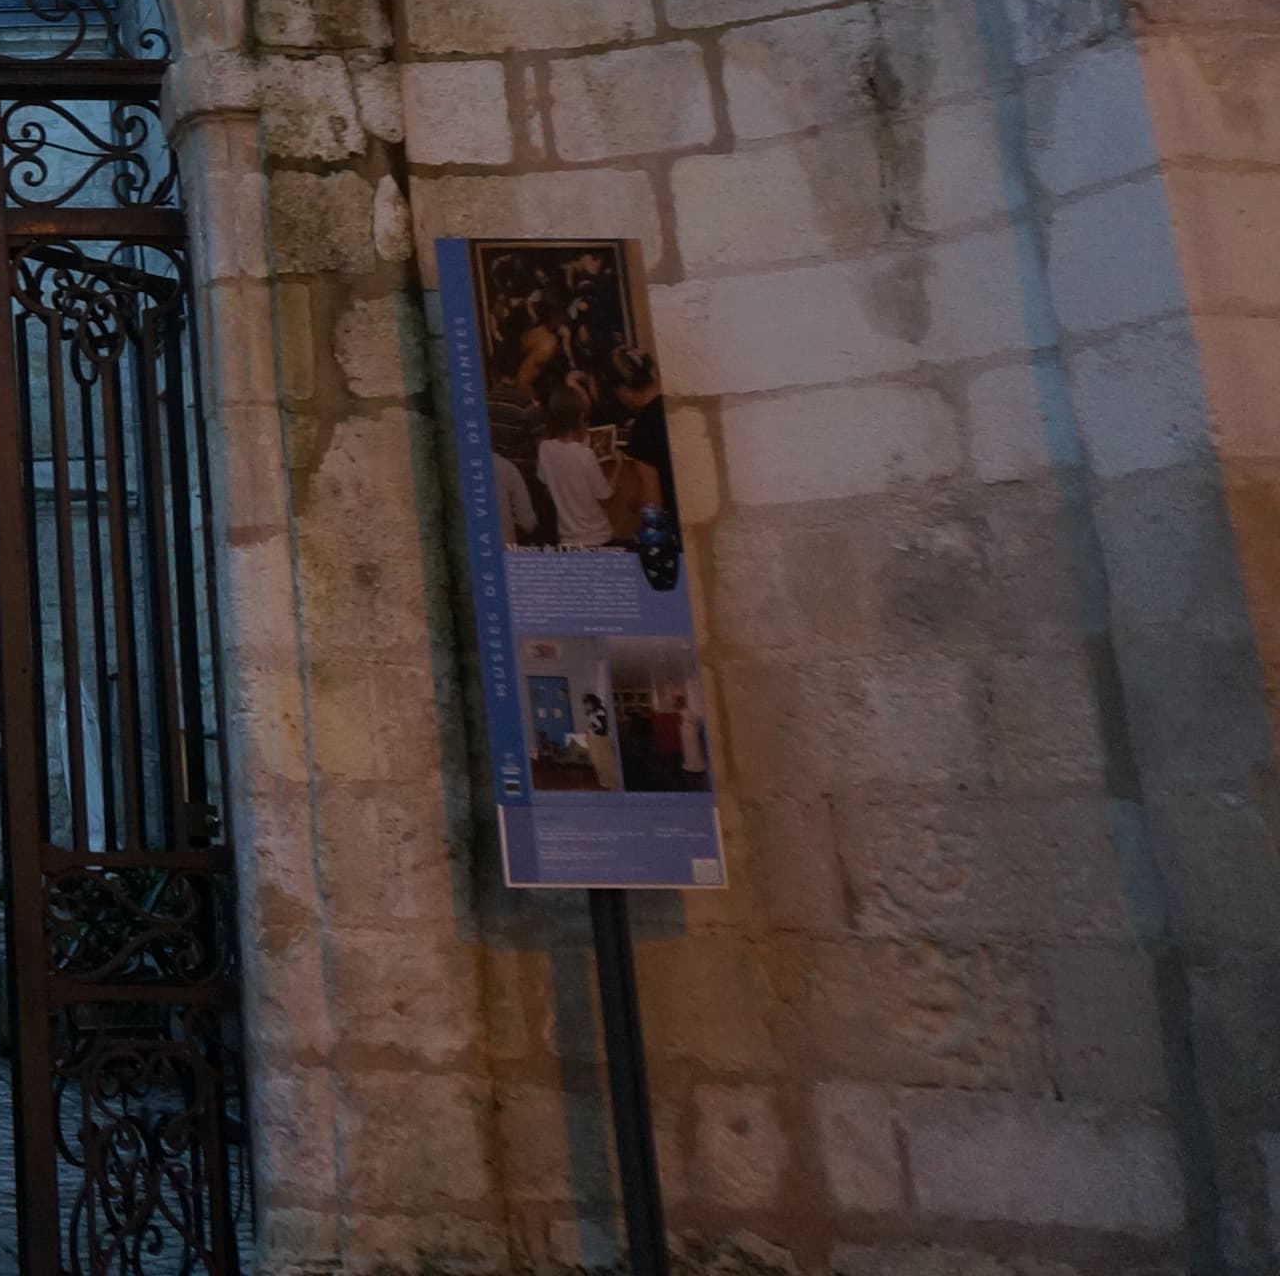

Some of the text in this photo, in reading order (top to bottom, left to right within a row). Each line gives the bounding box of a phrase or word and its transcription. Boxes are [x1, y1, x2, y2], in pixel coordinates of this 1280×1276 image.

[454, 315, 475, 405] SAINTES
[463, 420, 479, 444] DE
[466, 458, 488, 517] VILLE
[478, 533, 493, 565] LA
[482, 573, 497, 598] DE
